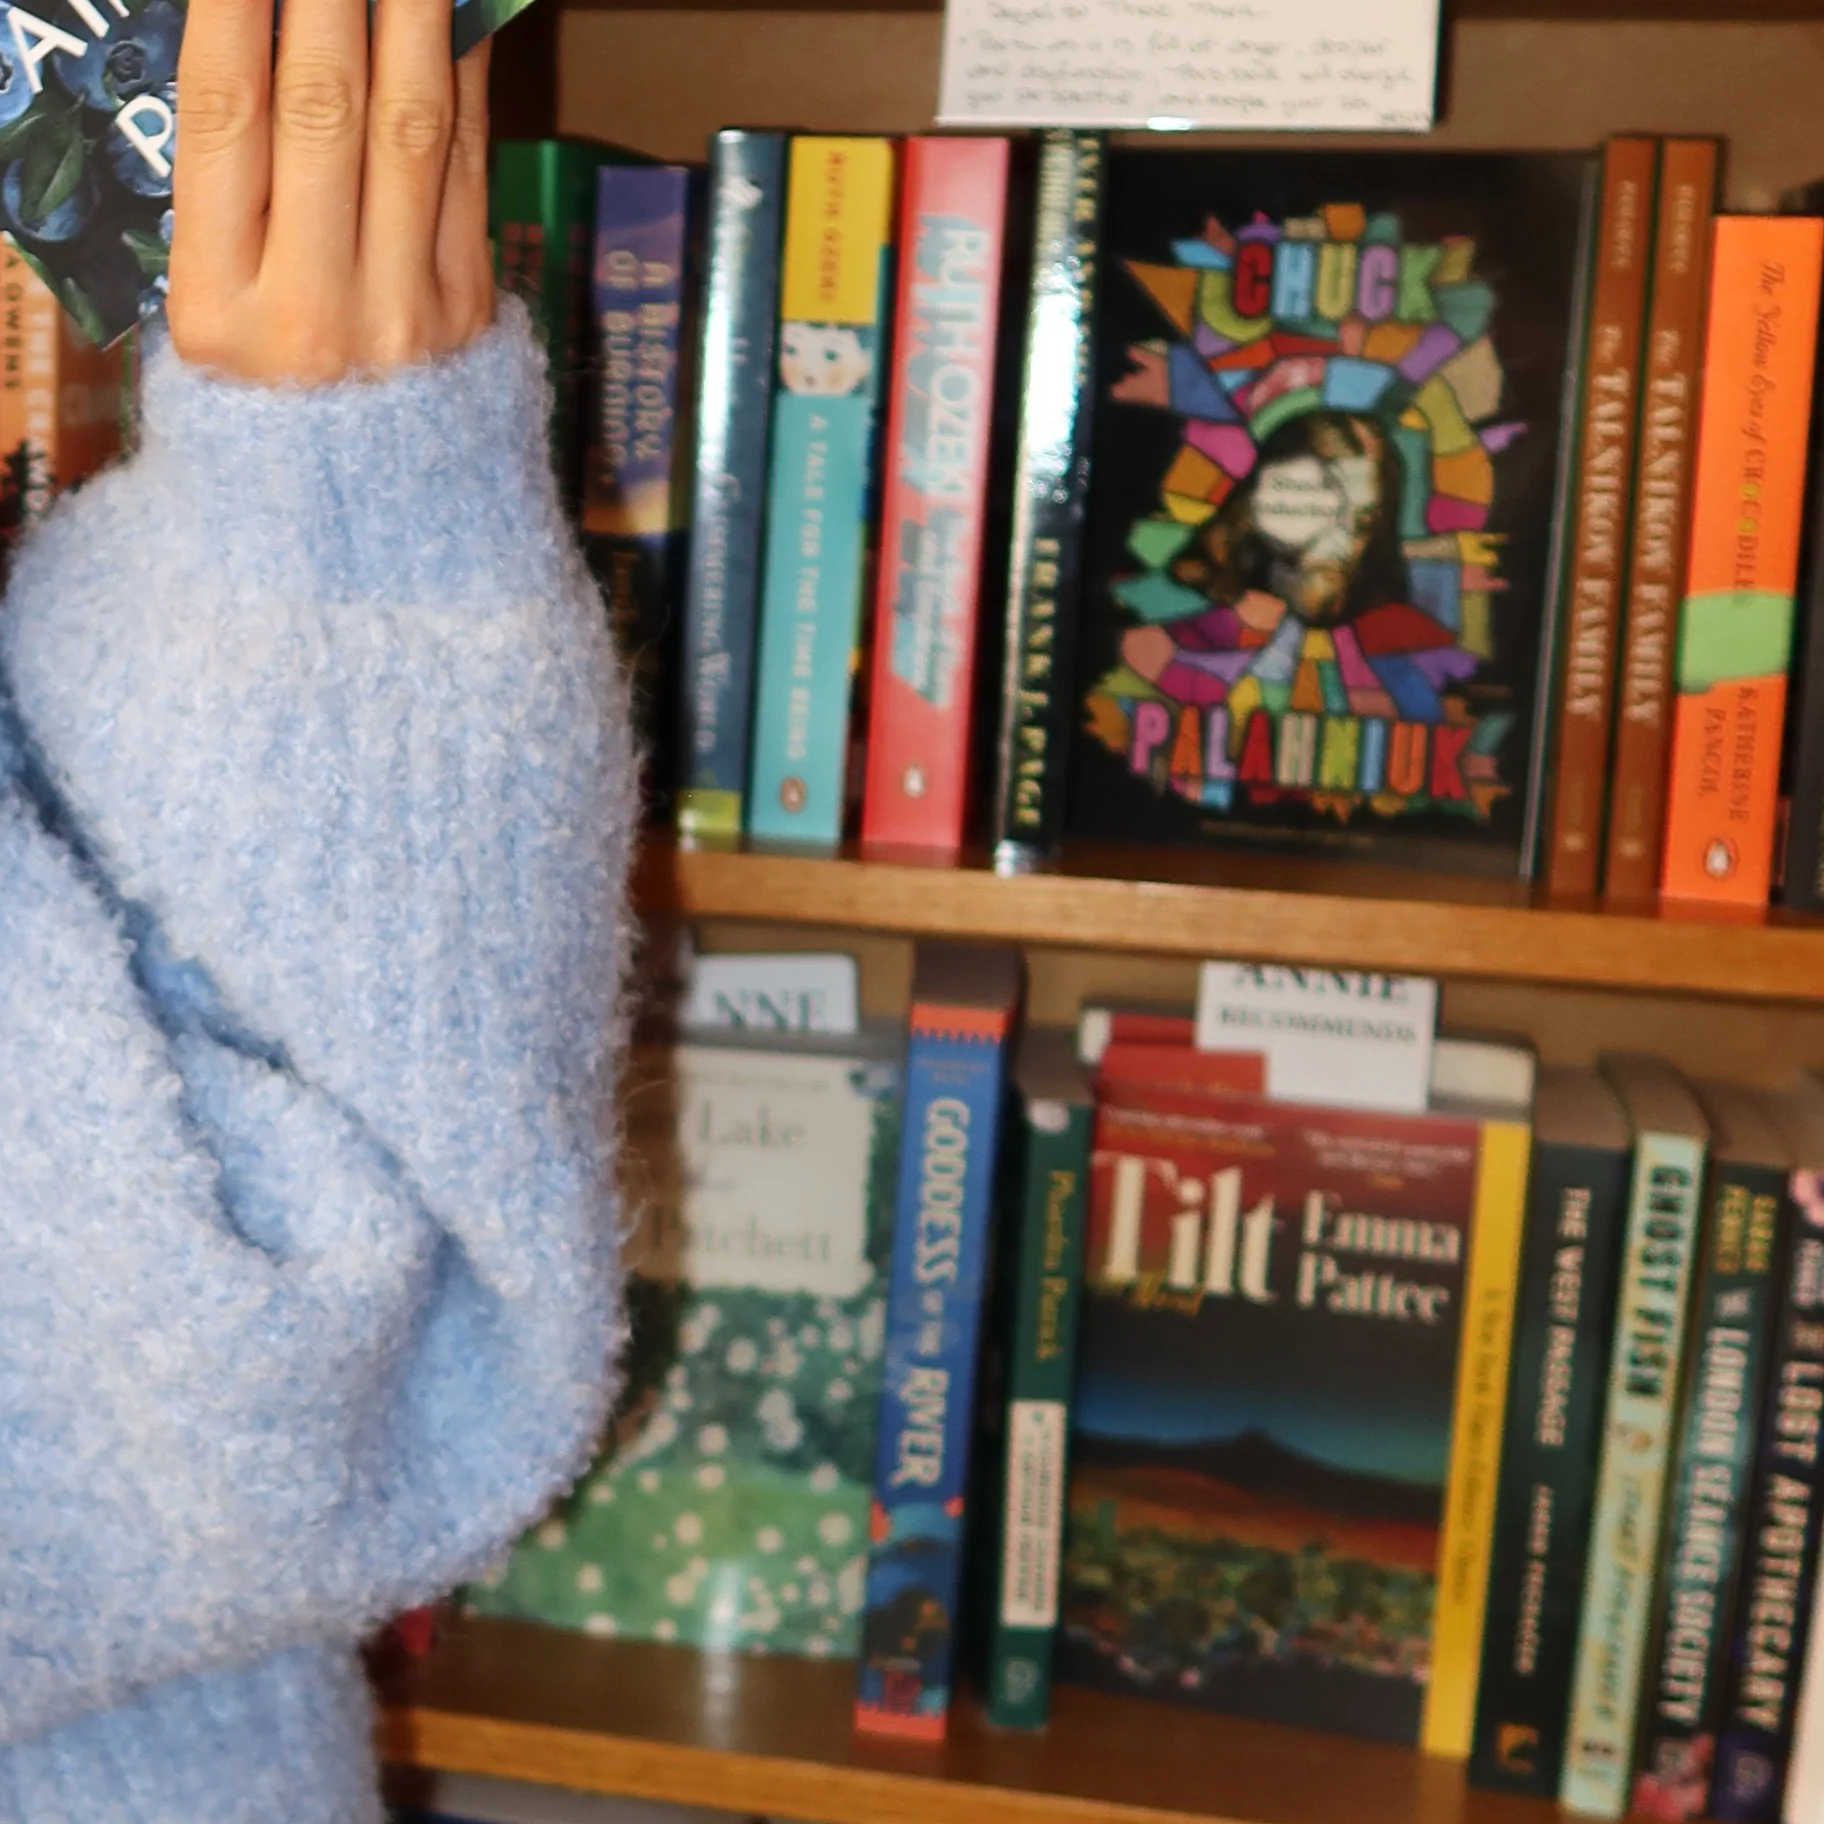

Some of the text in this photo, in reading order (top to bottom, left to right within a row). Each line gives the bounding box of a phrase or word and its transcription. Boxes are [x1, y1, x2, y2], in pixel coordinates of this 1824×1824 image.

[1233, 240, 1441, 323] CHUCK
[1582, 369, 1632, 570] TALNIKOV
[1641, 373, 1688, 574] TALNIKOV
[785, 413, 828, 761] A TALE FOR THE TIME BEING
[1569, 578, 1609, 718] FAMILY
[1628, 583, 1669, 726] FAMILY
[1129, 709, 1474, 805] PALAHNIUK
[1219, 1004, 1418, 1043] RECOMMENDS
[1237, 963, 1409, 1005] ANNIE
[917, 1098, 972, 1285] GODDESS
[1092, 1150, 1283, 1305] Tilt
[1303, 1191, 1462, 1265] Emma
[1297, 1251, 1450, 1324] Pattee
[1536, 1185, 1592, 1447] THE WEST PASSAGE
[1622, 1164, 1692, 1400] GHOST FISH
[889, 1366, 950, 1489] RIVER
[1659, 1328, 1752, 1725] LONDON SÉANCE SOCIETY
[1743, 1360, 1823, 1729] LOST APOTHECARY
